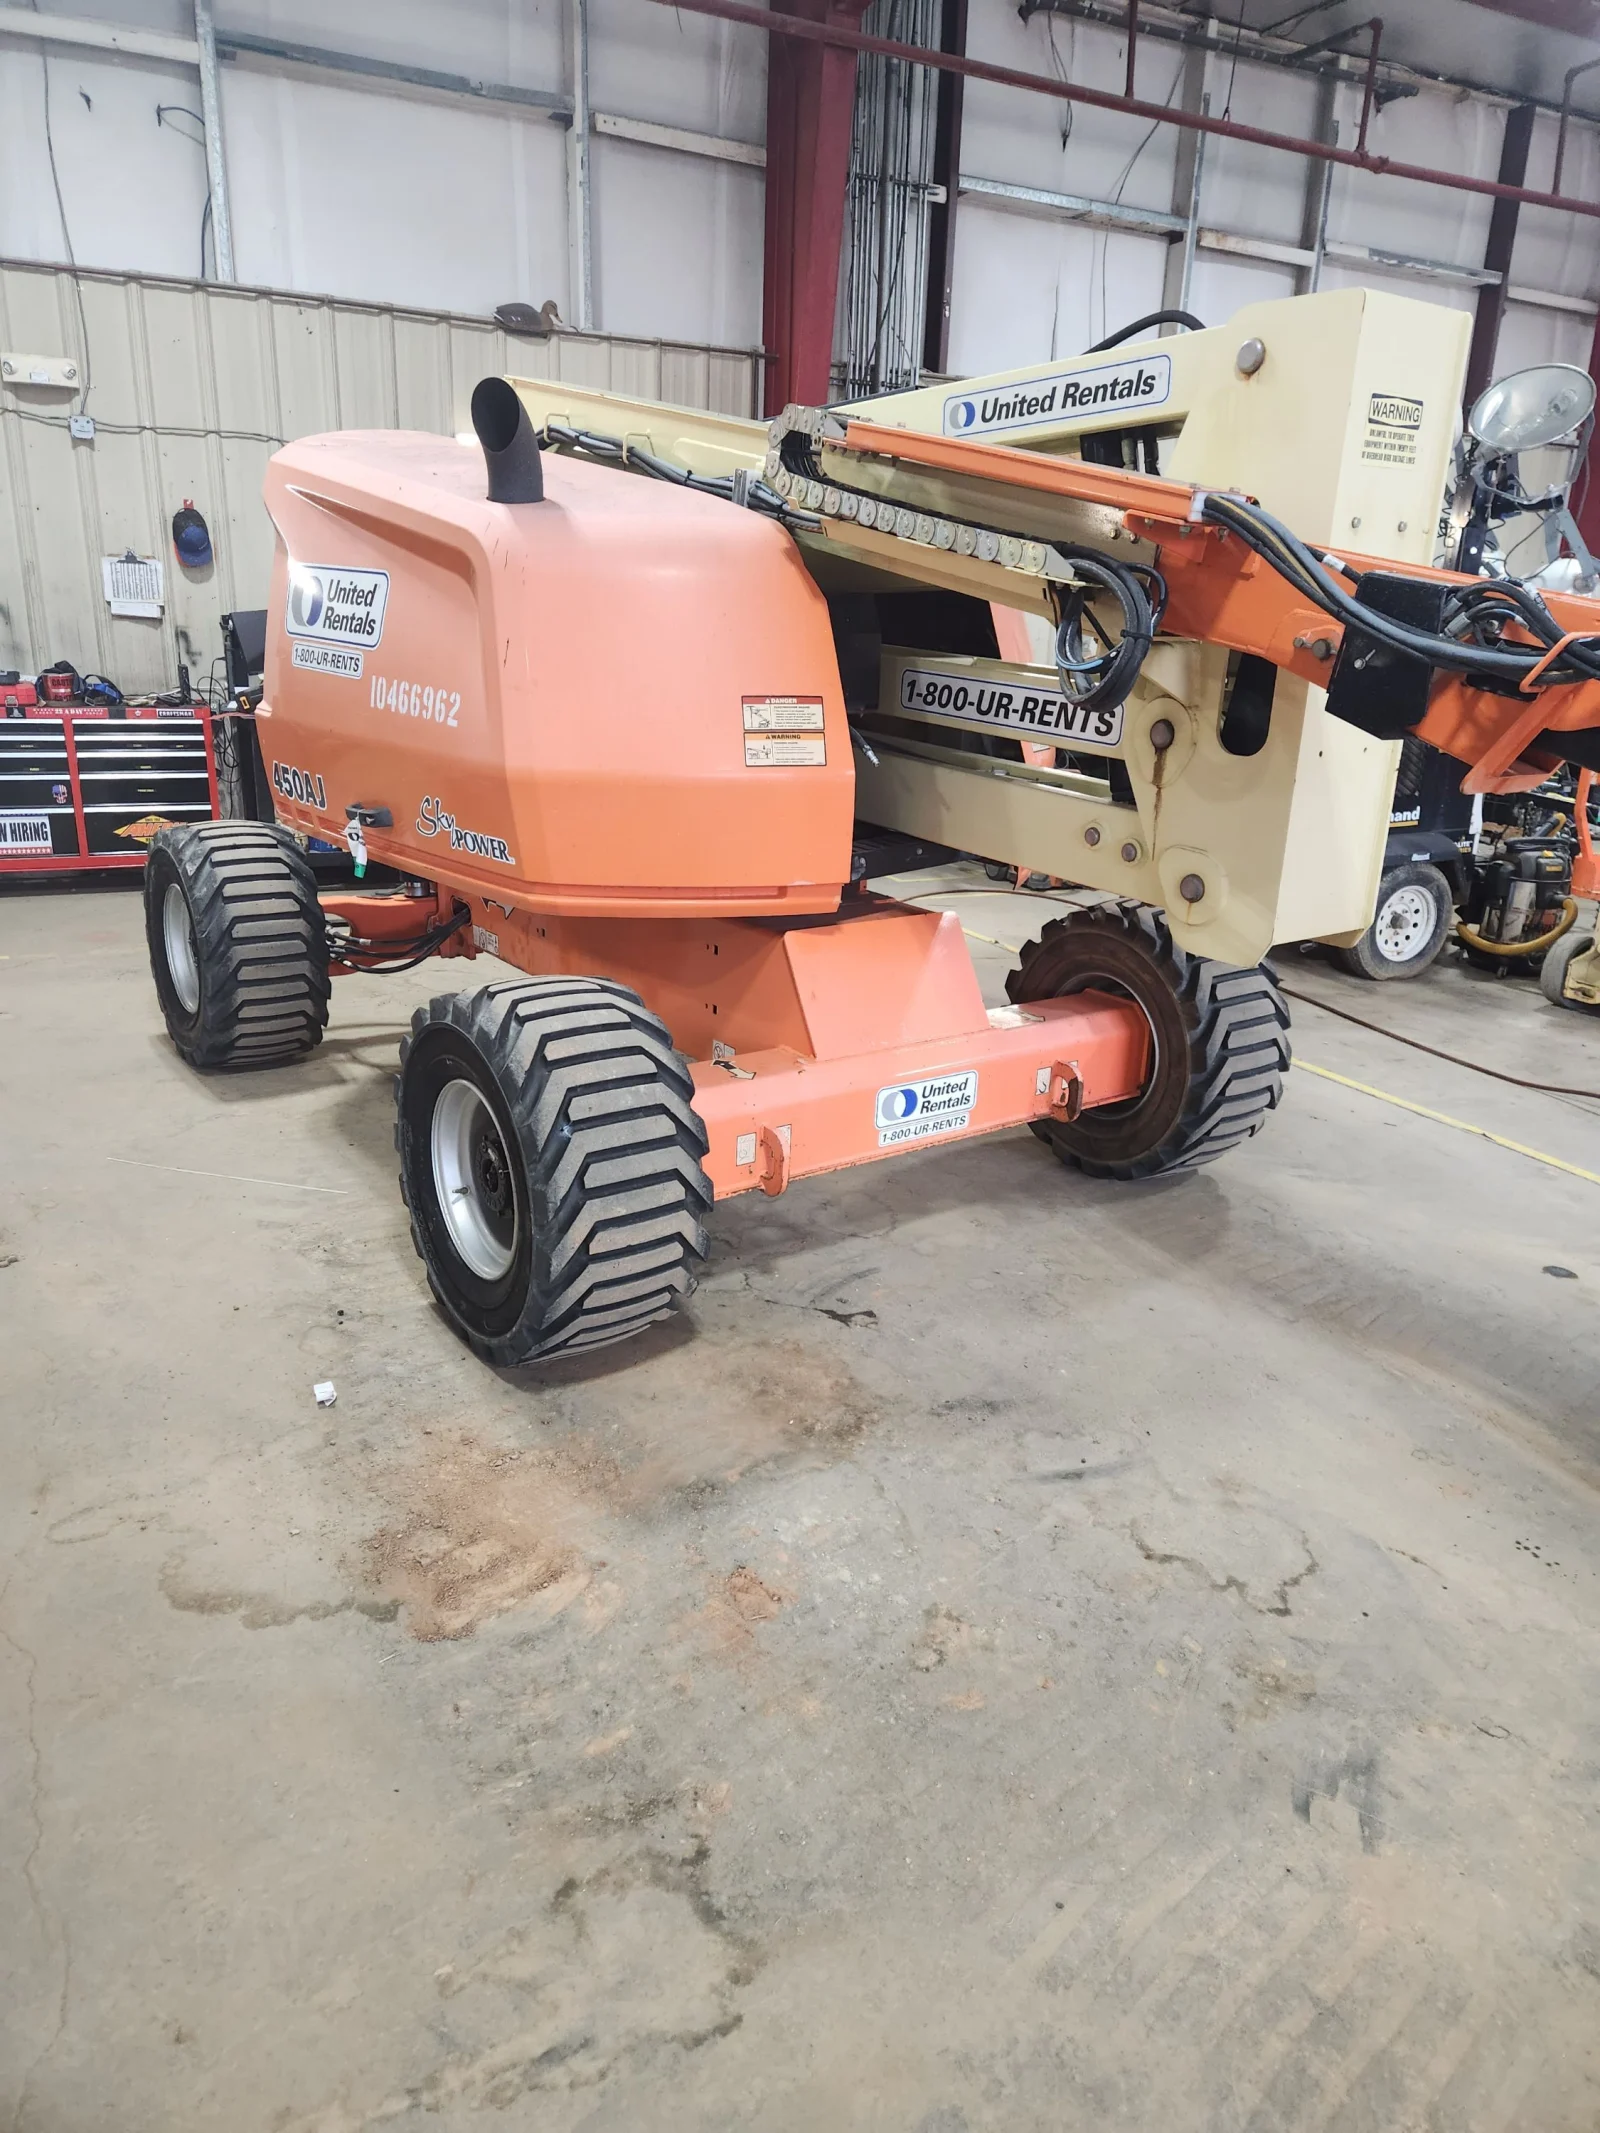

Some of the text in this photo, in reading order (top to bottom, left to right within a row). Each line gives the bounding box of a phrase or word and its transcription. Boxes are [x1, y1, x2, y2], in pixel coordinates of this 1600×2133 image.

[981, 369, 1156, 424] United Rentals
[1372, 400, 1420, 423] WARNING
[327, 579, 379, 608] United
[322, 606, 376, 636] Rentals
[294, 647, 360, 673] 1-800-UR-RENTS
[370, 675, 461, 728] 10466962
[906, 679, 1116, 737] 1-800-UR-RENTS
[272, 760, 327, 811] 450AJ
[9, 821, 49, 842] HIRING
[416, 796, 511, 864] Sky POWER
[922, 1077, 969, 1099] United
[920, 1093, 971, 1114] Rentals
[882, 1115, 966, 1143] 1-800-UR-RENTS
